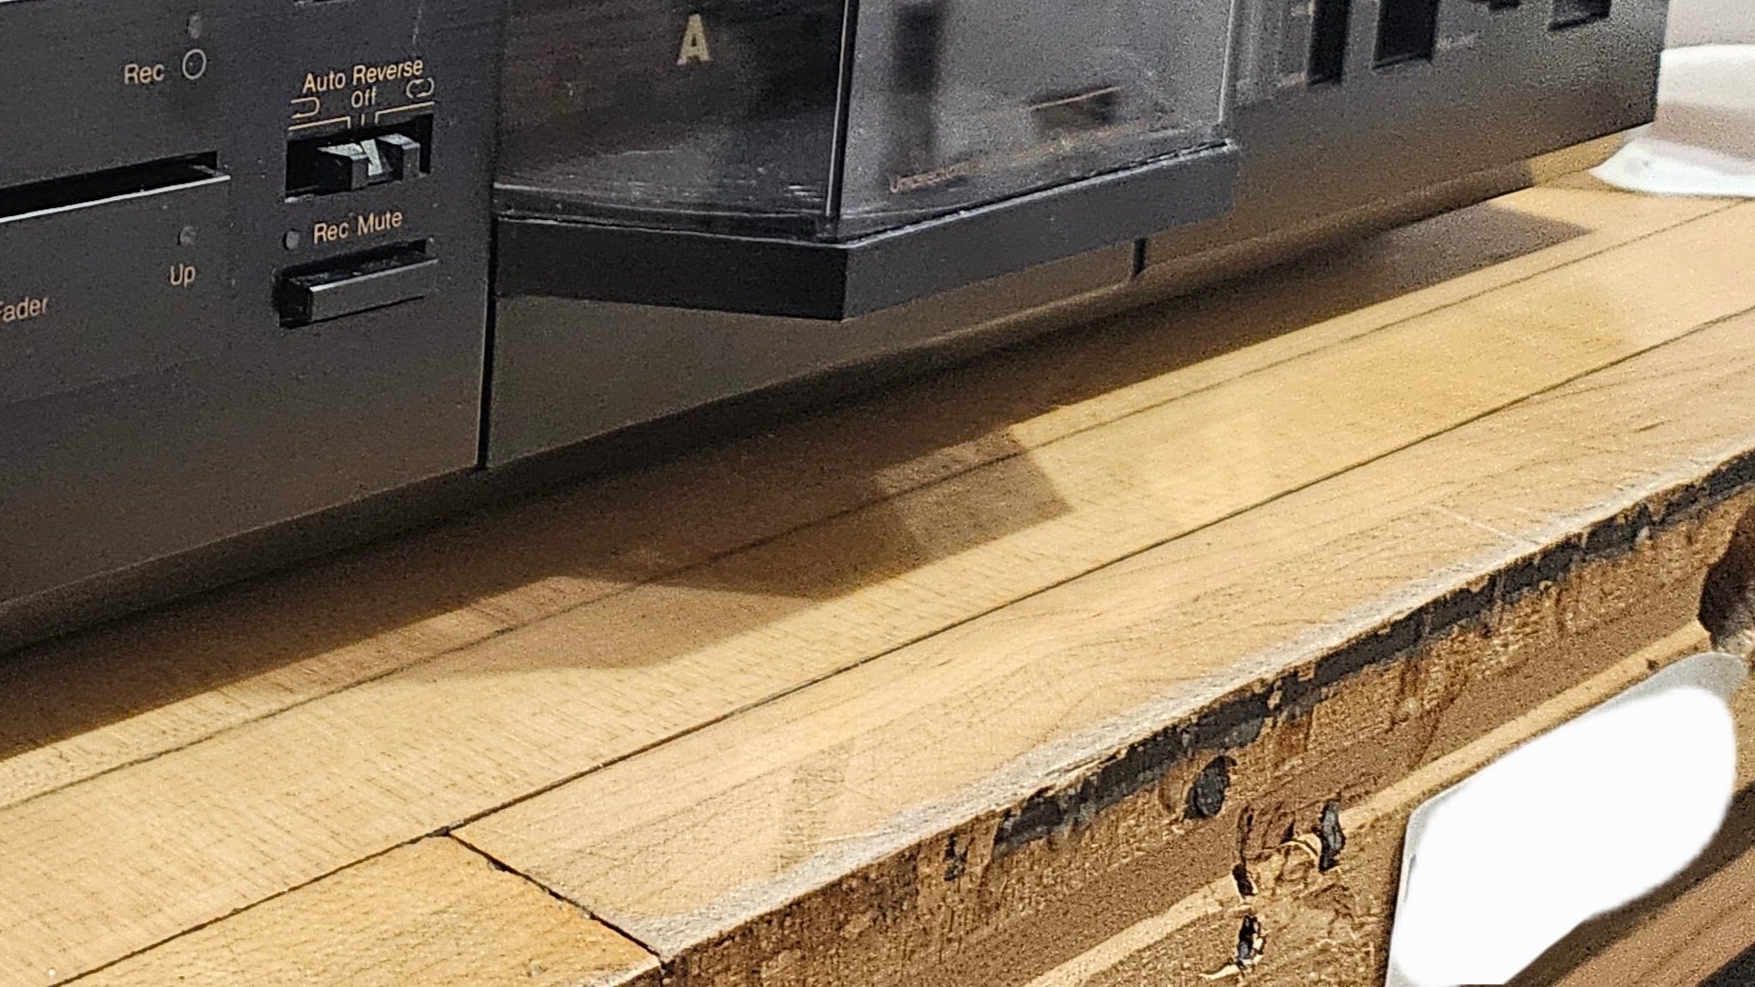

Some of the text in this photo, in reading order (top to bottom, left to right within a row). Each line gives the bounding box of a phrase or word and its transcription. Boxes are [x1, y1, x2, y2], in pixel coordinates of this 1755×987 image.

[678, 14, 711, 66] A
[123, 62, 166, 86] Rec
[302, 58, 425, 95] Auto Reverse
[350, 87, 378, 109] Off
[312, 211, 405, 244] Rec Mute
[169, 263, 197, 288] Up
